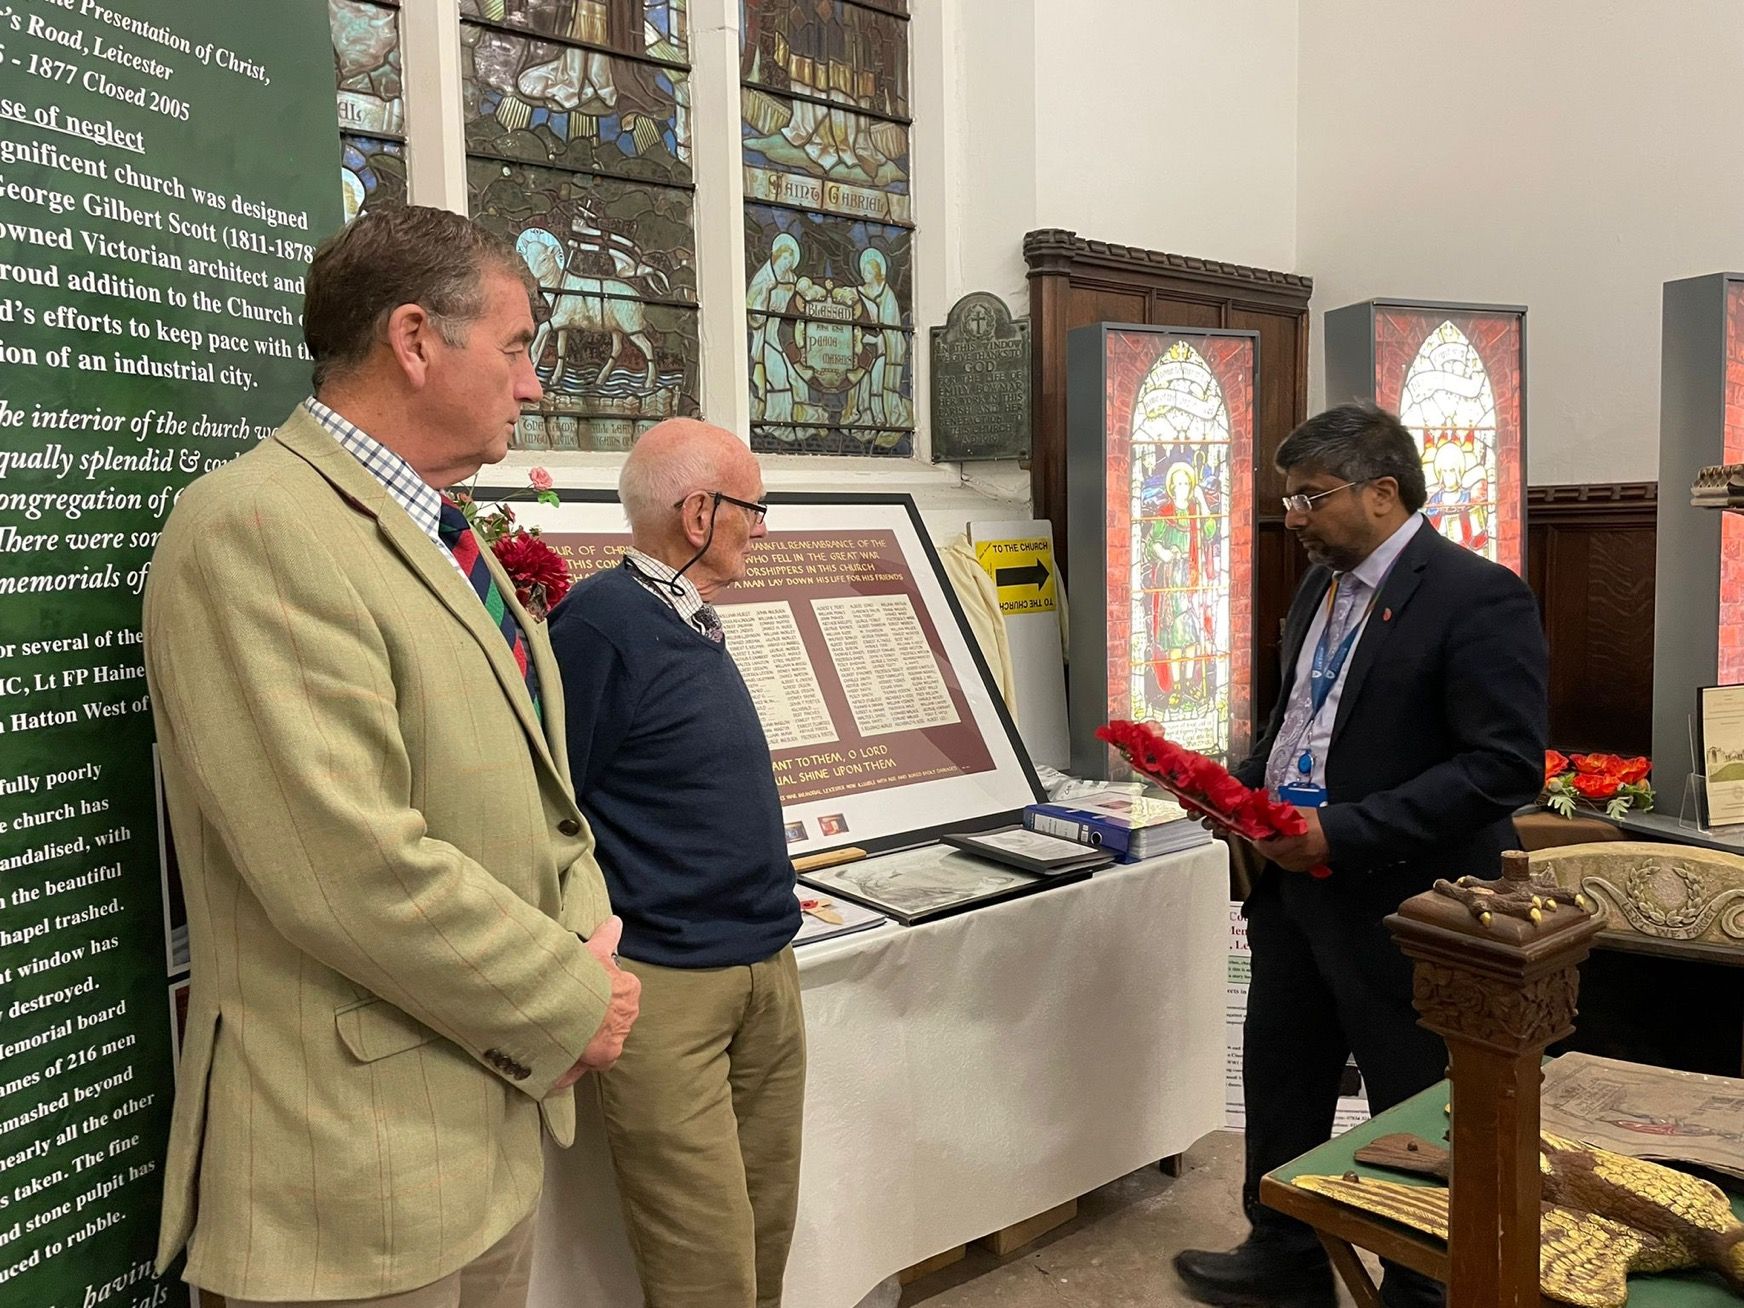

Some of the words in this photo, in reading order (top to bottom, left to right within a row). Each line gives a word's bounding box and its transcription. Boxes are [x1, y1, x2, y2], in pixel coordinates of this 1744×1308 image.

[0, 6, 21, 30] 's
[27, 14, 88, 56] Road,
[93, 36, 173, 80] Leicester
[80, 0, 190, 53] Presentation
[195, 44, 214, 64] of
[215, 48, 271, 85] Christ,
[27, 54, 78, 84] 1877
[83, 71, 146, 106] Closed
[150, 92, 190, 120] 2005
[34, 105, 60, 128] of
[66, 114, 146, 151] neglect
[1, 141, 108, 179] gnificent
[115, 164, 185, 199] church
[192, 188, 226, 209] was
[232, 194, 308, 230] designed
[83, 194, 162, 230] Gilbert
[169, 213, 217, 242] Scott
[223, 227, 316, 264] (1811-1878
[80, 231, 182, 270] Victorian
[188, 259, 268, 288] architect
[274, 276, 305, 294] and
[0, 264, 59, 287] roud
[68, 271, 161, 303] addition
[168, 287, 186, 307] to
[193, 291, 221, 313] the
[227, 297, 293, 325] Church
[0, 299, 35, 324] d's
[44, 306, 122, 334] efforts
[129, 318, 150, 338] to
[156, 320, 202, 350] keep
[208, 334, 248, 353] pace
[254, 339, 292, 358] with
[46, 346, 71, 368] of
[78, 354, 107, 371] an
[114, 352, 214, 382] industrial
[220, 368, 257, 391] city.
[964, 361, 995, 372] GOD
[32, 404, 126, 431] interior
[131, 410, 156, 441] of
[156, 412, 187, 434] the
[192, 414, 249, 439] church
[79, 446, 174, 479] splendid
[179, 449, 200, 472] &
[148, 486, 172, 518] of
[66, 533, 124, 549] were
[578, 545, 596, 555] OF
[788, 540, 856, 550] REMEMBRANCE
[857, 540, 869, 548] OF
[871, 540, 887, 548] THE
[992, 544, 1003, 553] TO
[1004, 543, 1019, 552] THE
[1020, 542, 1048, 551] CHURCH
[127, 562, 151, 594] of
[566, 559, 593, 569] THIS
[772, 553, 792, 563] FELL
[793, 553, 804, 562] IN
[807, 552, 827, 561] THE
[830, 551, 858, 560] GREAT
[860, 551, 880, 559] WAR
[806, 565, 817, 574] IN
[818, 564, 837, 573] THIS
[839, 563, 875, 572] CHURCH
[743, 579, 765, 588] MAN
[768, 578, 783, 587] LAY
[786, 577, 814, 585] DOWN
[830, 575, 845, 583] LIFE
[846, 574, 861, 582] FOR
[1030, 600, 1042, 608] THE
[22, 633, 89, 655] several
[95, 631, 112, 647] of
[118, 629, 143, 644] the
[34, 674, 56, 690] Lt
[62, 669, 88, 687] FP
[93, 664, 145, 683] Haine
[10, 711, 77, 731] Hatton
[83, 701, 126, 719] West
[132, 696, 148, 712] of
[794, 757, 810, 768] TO
[809, 752, 846, 764] THEM,
[848, 749, 857, 759] O
[860, 744, 888, 758] LORD
[799, 768, 830, 783] SHINE
[832, 763, 862, 777] UPON
[863, 758, 897, 771] THEM
[46, 763, 101, 790] poorly
[13, 804, 74, 829] church
[81, 800, 108, 814] has
[0, 837, 90, 871] andalised,
[95, 827, 130, 846] with
[12, 888, 39, 905] the
[45, 863, 121, 896] beautiful
[0, 918, 49, 946] hapel
[55, 898, 125, 929] trashed.
[18, 948, 84, 977] window
[91, 937, 118, 954] has
[9, 976, 99, 1018] destroyed.
[78, 1000, 126, 1030] board
[45, 1059, 63, 1078] of
[68, 1045, 96, 1070] 216
[102, 1035, 135, 1055] men
[74, 1066, 132, 1102] beyond
[56, 1124, 77, 1146] all
[83, 1115, 108, 1133] the
[114, 1094, 154, 1119] other
[15, 1171, 68, 1201] taken.
[72, 1152, 104, 1172] The
[110, 1135, 138, 1156] fine
[26, 1202, 70, 1232] stone
[76, 1174, 124, 1211] pulpit
[130, 1162, 154, 1180] has
[45, 1243, 62, 1258] to
[68, 1212, 125, 1247] rubble.
